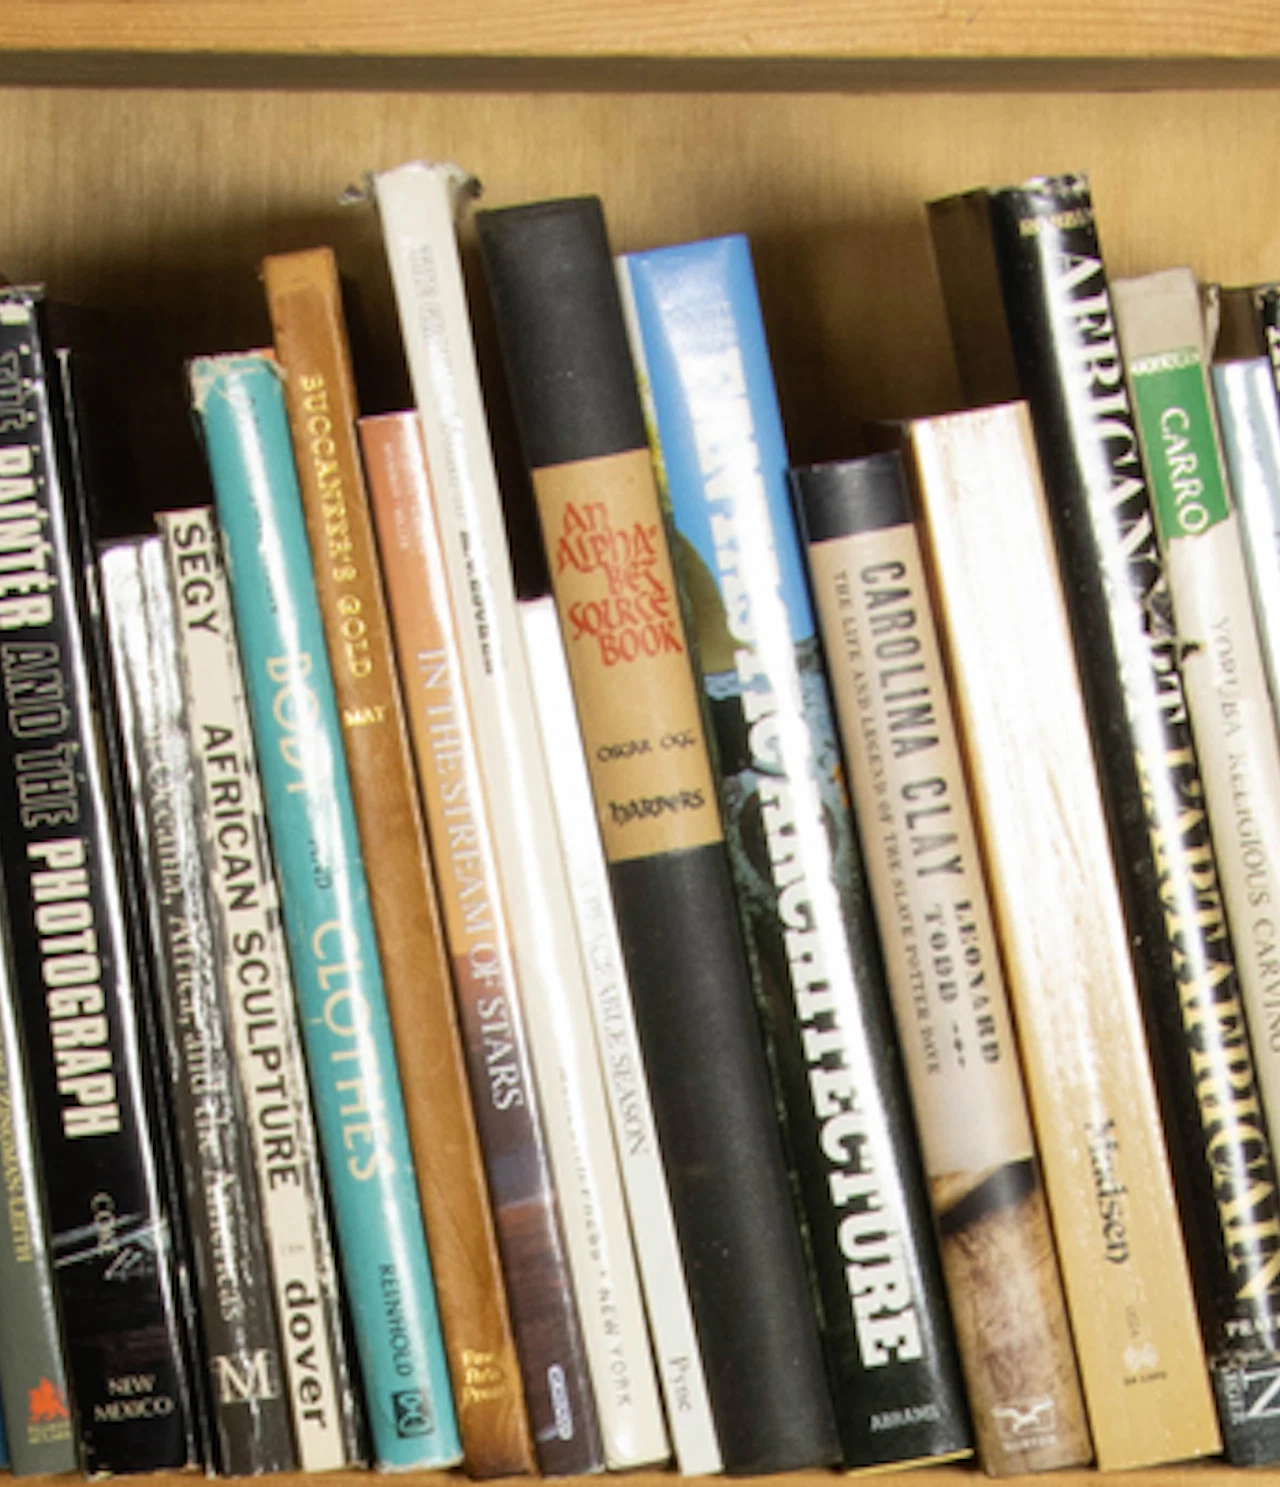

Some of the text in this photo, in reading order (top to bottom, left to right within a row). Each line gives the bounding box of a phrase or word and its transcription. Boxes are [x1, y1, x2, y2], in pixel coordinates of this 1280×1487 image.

[173, 524, 221, 635] SEGY
[11, 743, 80, 827] THE
[859, 560, 965, 880] CAROLINA CLAY
[24, 836, 121, 1139] PHOTOGRAPH
[203, 724, 300, 1190] AFRICAN SCULPTURE
[922, 903, 960, 1004] TODD
[951, 899, 1001, 1064] LEONARD
[281, 1278, 332, 1428] dover
[375, 1261, 416, 1376] REINHOLD
